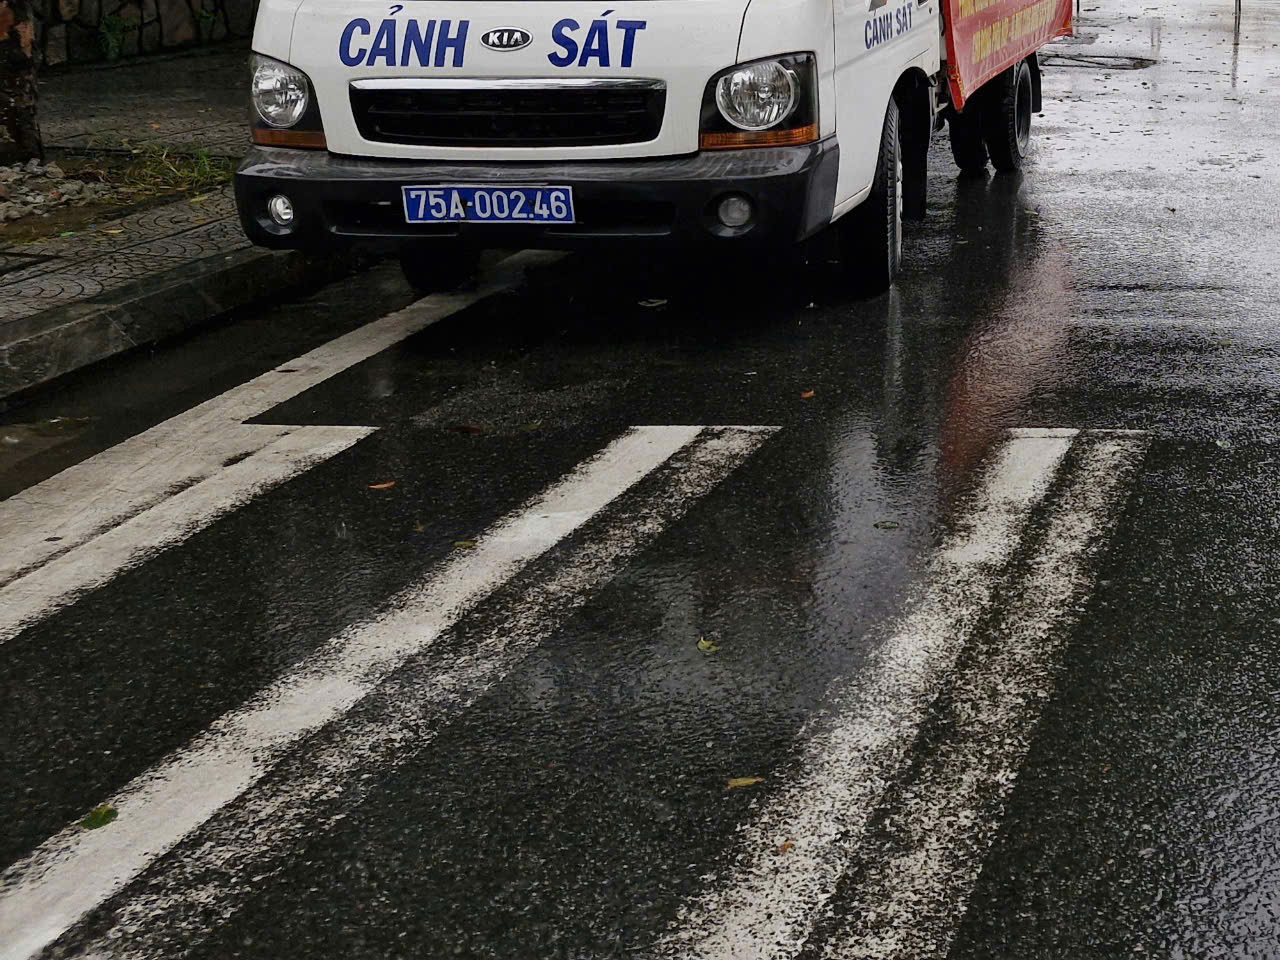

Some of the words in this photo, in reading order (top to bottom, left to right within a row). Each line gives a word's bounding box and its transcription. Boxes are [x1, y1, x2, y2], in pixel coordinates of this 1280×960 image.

[339, 4, 470, 68] CẢNH
[547, 9, 647, 68] SÁT
[487, 31, 524, 46] KIA
[864, 9, 893, 50] CẢNH
[410, 190, 568, 219] 75A-002.46
